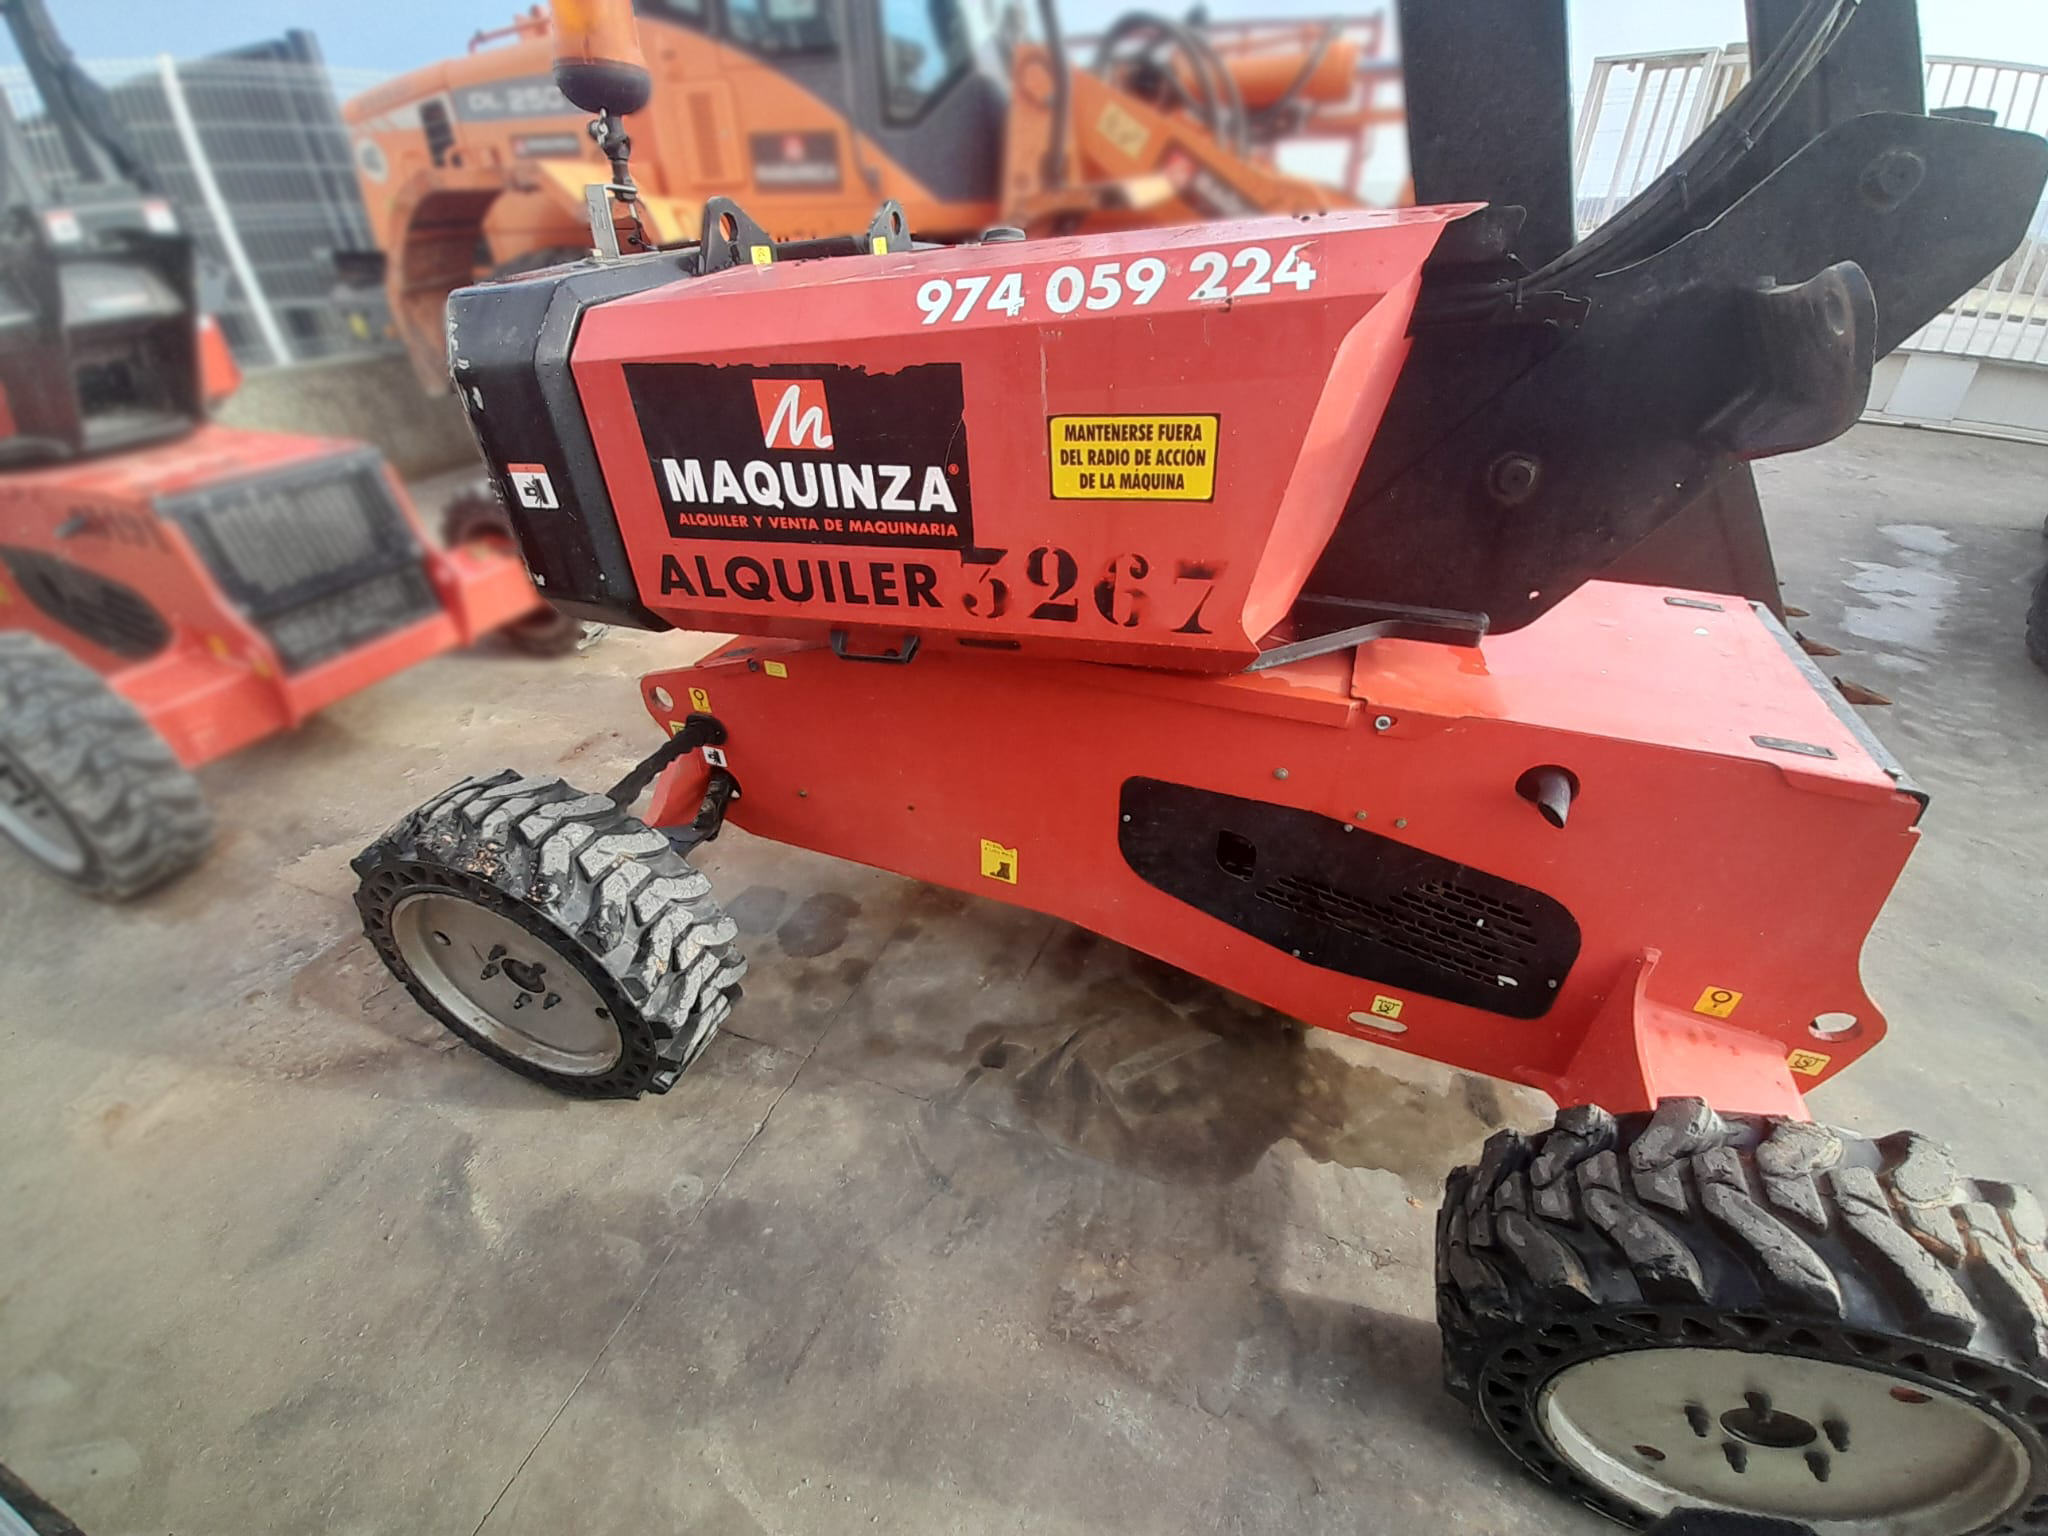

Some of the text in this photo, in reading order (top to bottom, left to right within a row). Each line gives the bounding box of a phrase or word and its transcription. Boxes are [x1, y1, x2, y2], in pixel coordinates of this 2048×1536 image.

[915, 245, 1317, 325] 974 059 224
[1064, 423, 1202, 442] MANTENERSE FUERA
[1060, 444, 1206, 467] DEL RADIO DE ACCIÓN
[661, 458, 958, 513] MAQUINZA
[1079, 468, 1185, 492] DE LA MÁQUINA
[679, 513, 959, 537] ALQUILER Y VENTA DE MAQUINARIA
[660, 546, 1230, 635] ALQUILER 3267
